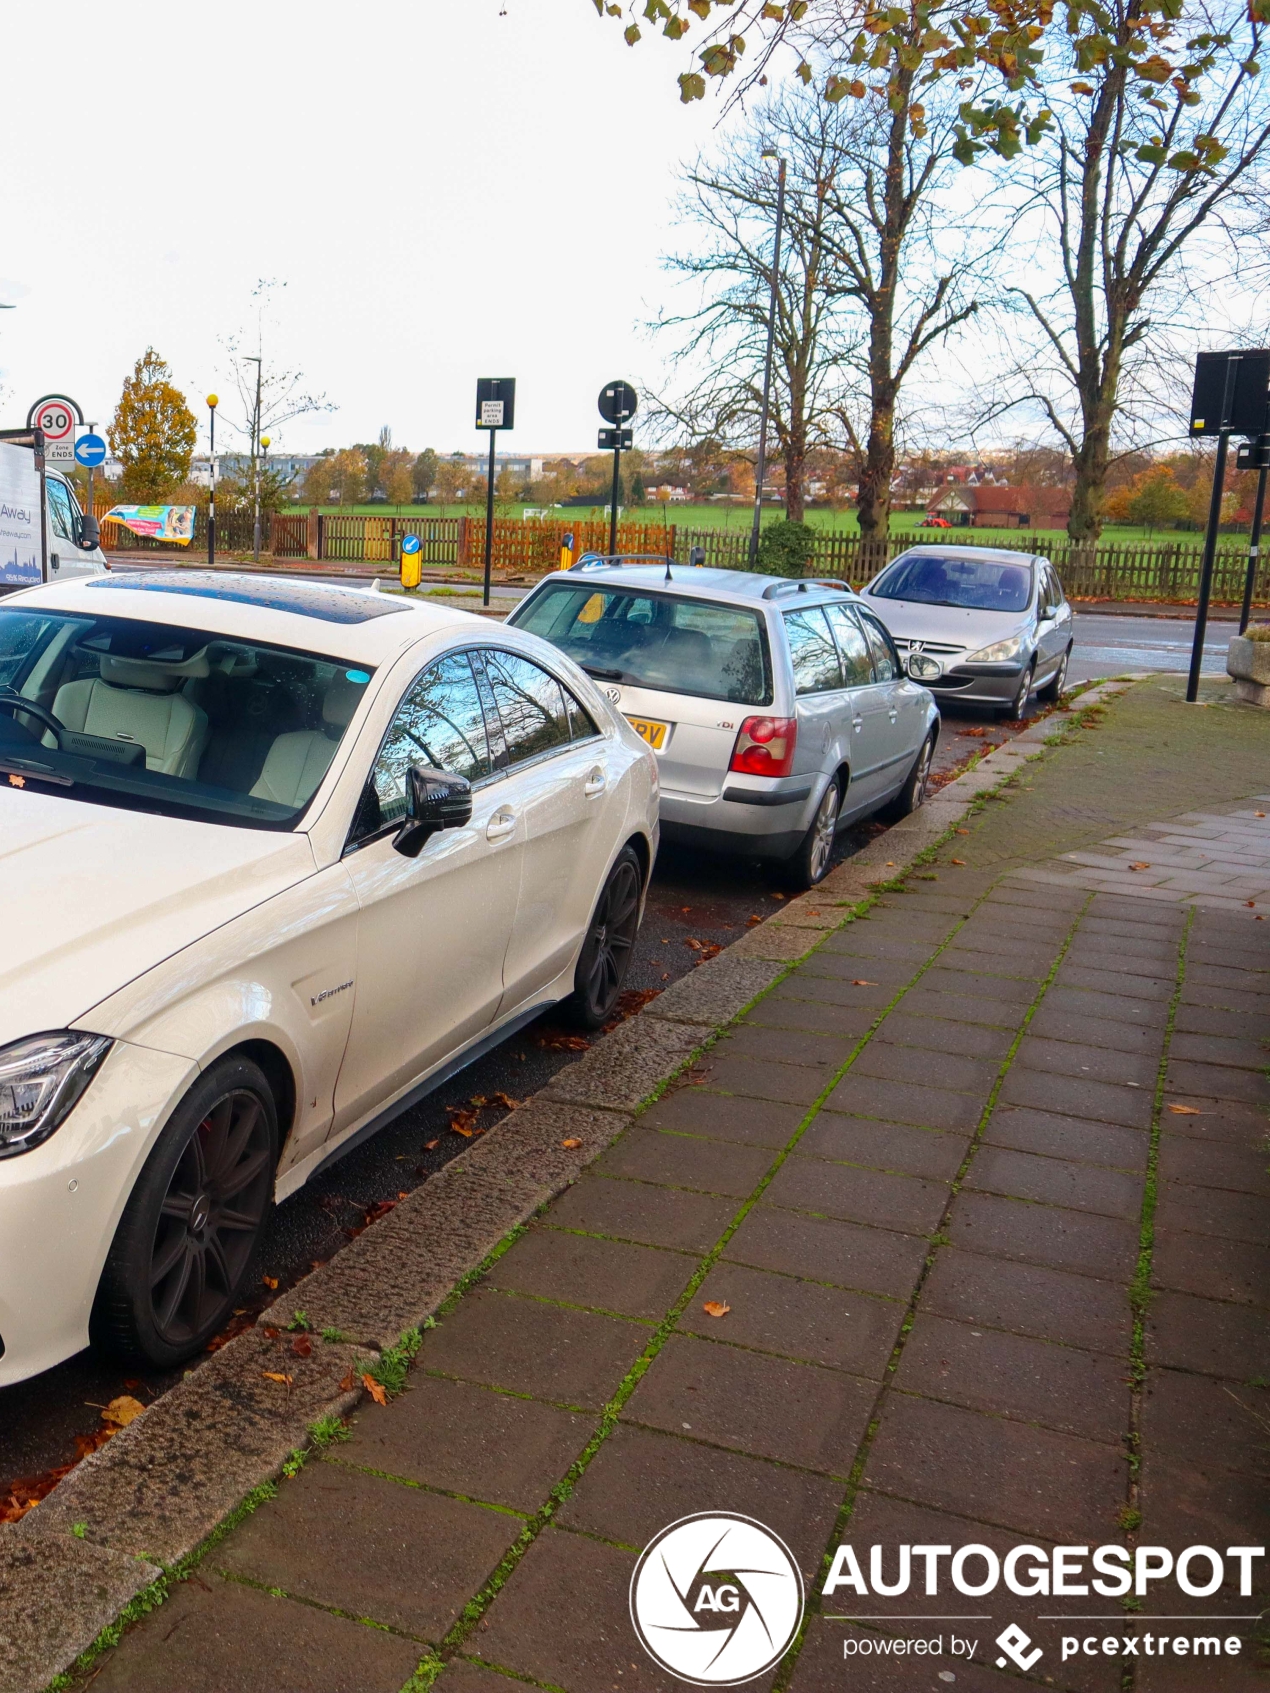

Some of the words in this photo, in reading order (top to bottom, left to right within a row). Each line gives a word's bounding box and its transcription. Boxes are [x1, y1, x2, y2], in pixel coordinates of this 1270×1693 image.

[43, 415, 67, 428] 30
[0, 504, 31, 524] Away
[18, 574, 41, 584] Recycled
[630, 722, 662, 744] RV
